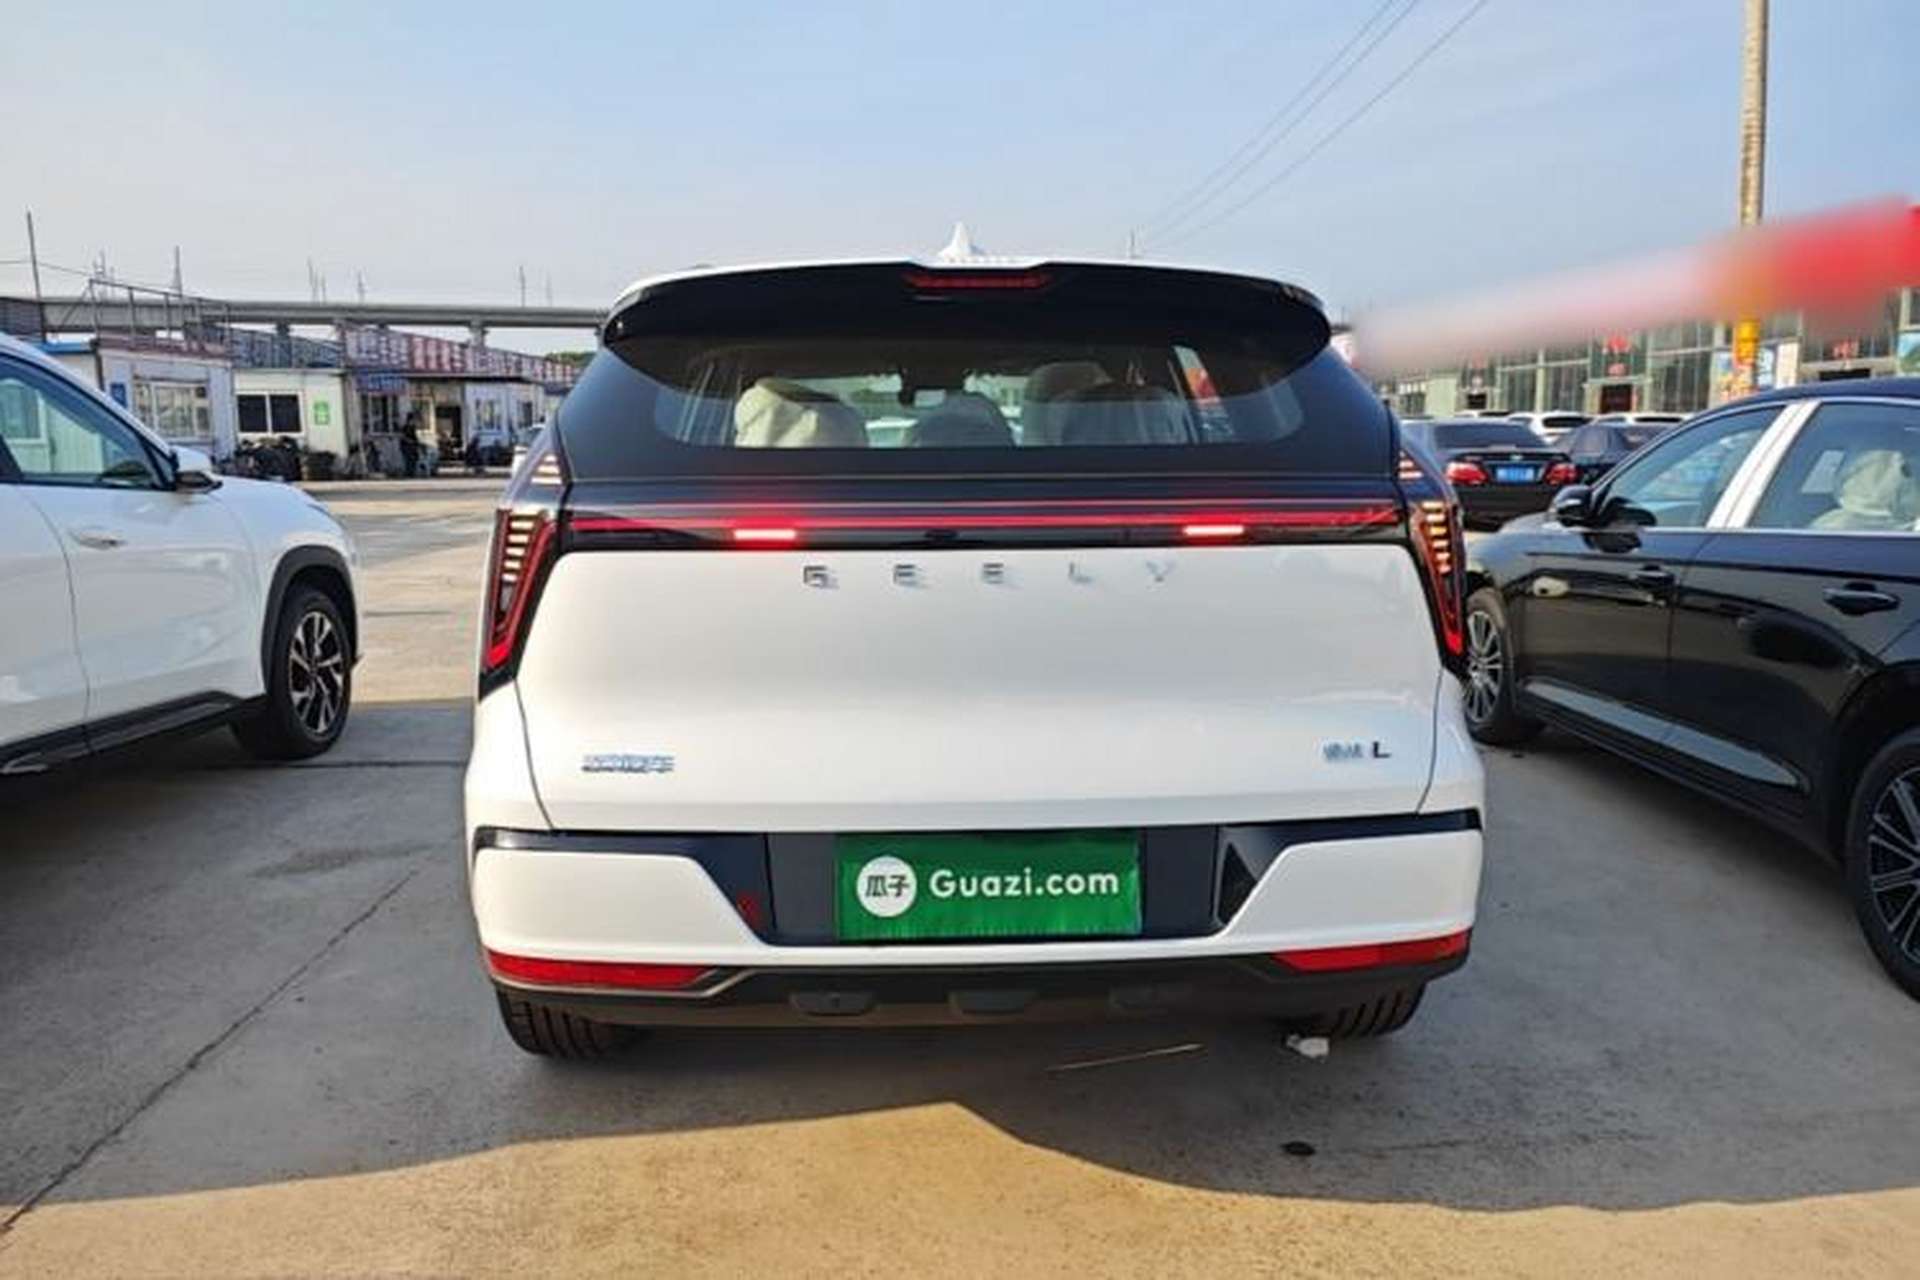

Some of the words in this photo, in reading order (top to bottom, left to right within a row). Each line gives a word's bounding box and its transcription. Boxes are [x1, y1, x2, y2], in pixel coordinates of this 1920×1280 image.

[803, 561, 1177, 588] GEELY
[1373, 741, 1392, 759] L
[865, 874, 910, 898] 瓜子
[929, 867, 1120, 899] Guazi.com
